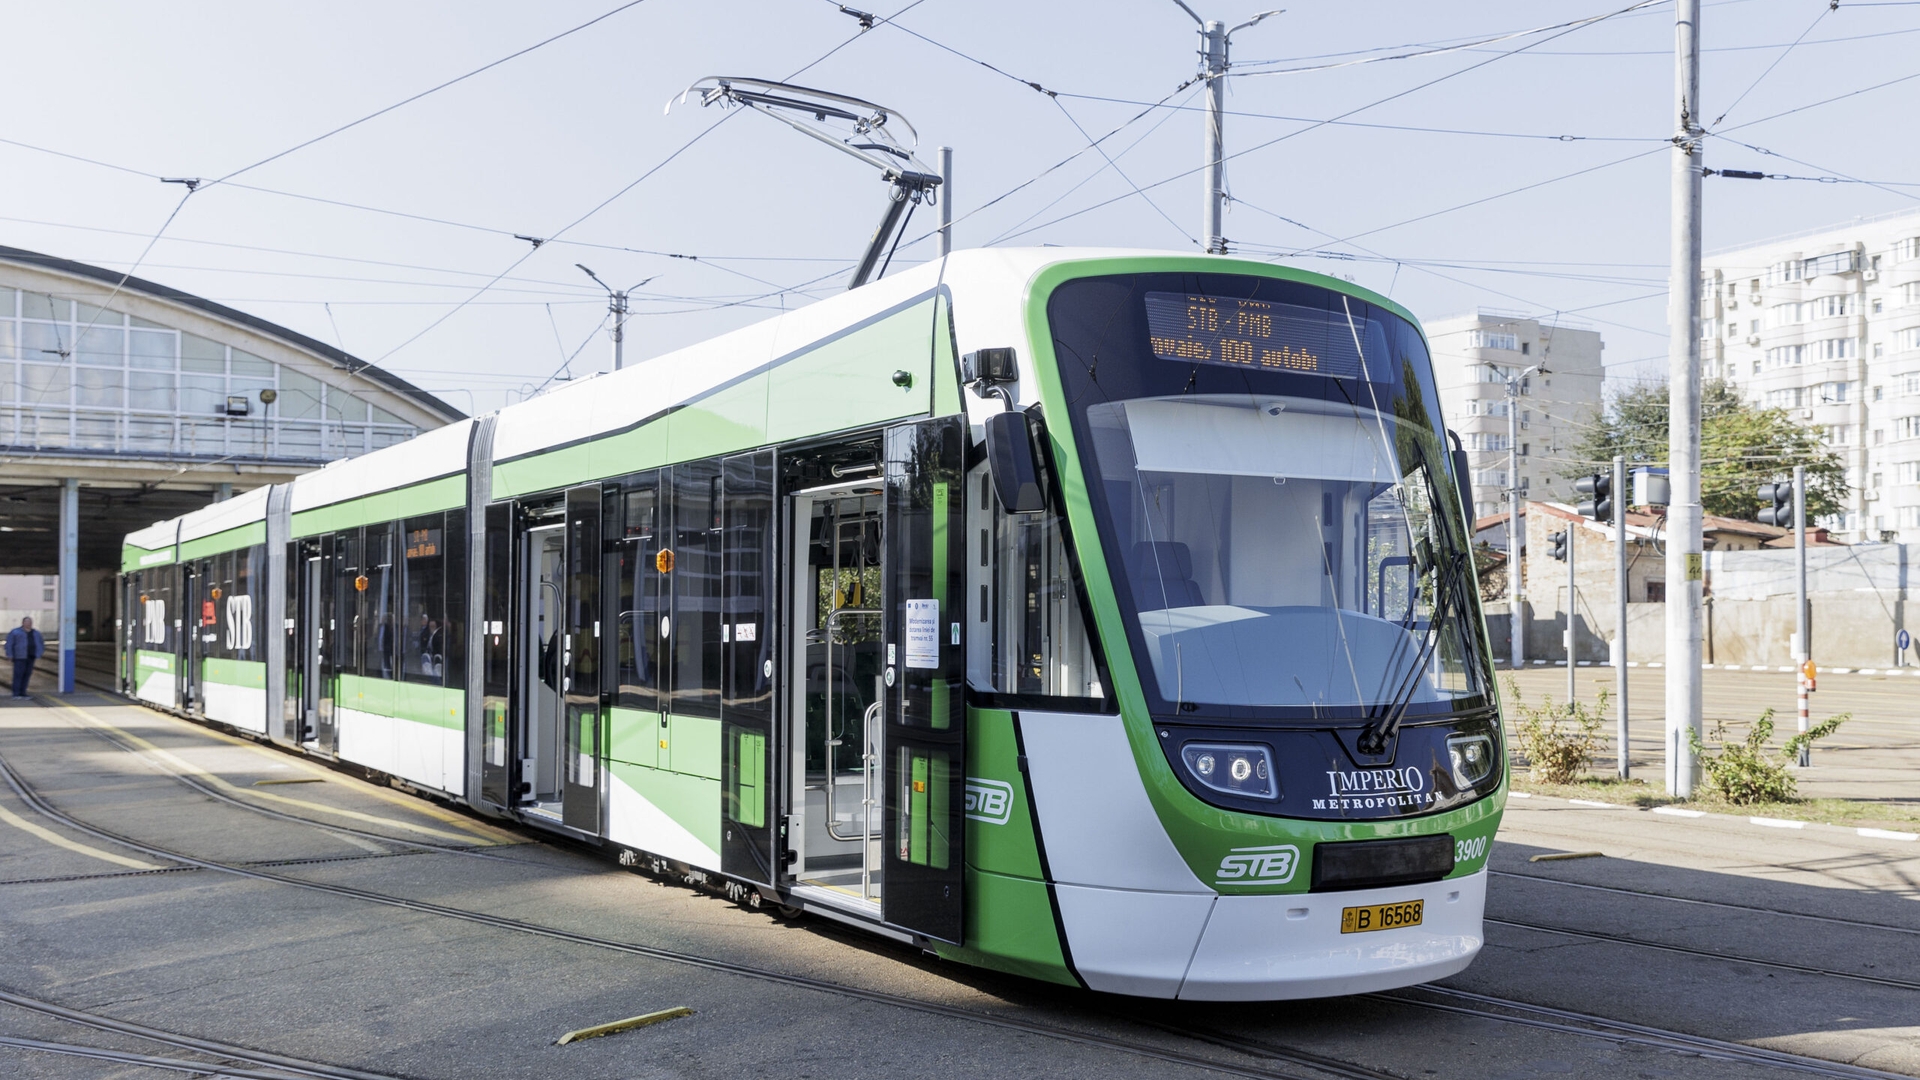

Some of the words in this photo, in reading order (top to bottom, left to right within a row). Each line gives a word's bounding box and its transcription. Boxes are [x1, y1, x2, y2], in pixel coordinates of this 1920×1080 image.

[1187, 305, 1218, 331] STB
[1238, 311, 1271, 338] PMB
[1220, 339, 1252, 365] 100
[226, 594, 252, 650] STB
[1327, 766, 1424, 797] IMPERIO
[1312, 790, 1444, 810] METROPOLITAN
[1454, 835, 1487, 863] 3900
[1215, 850, 1294, 880] STB
[1358, 909, 1371, 929] B
[1379, 903, 1421, 927] 16568
